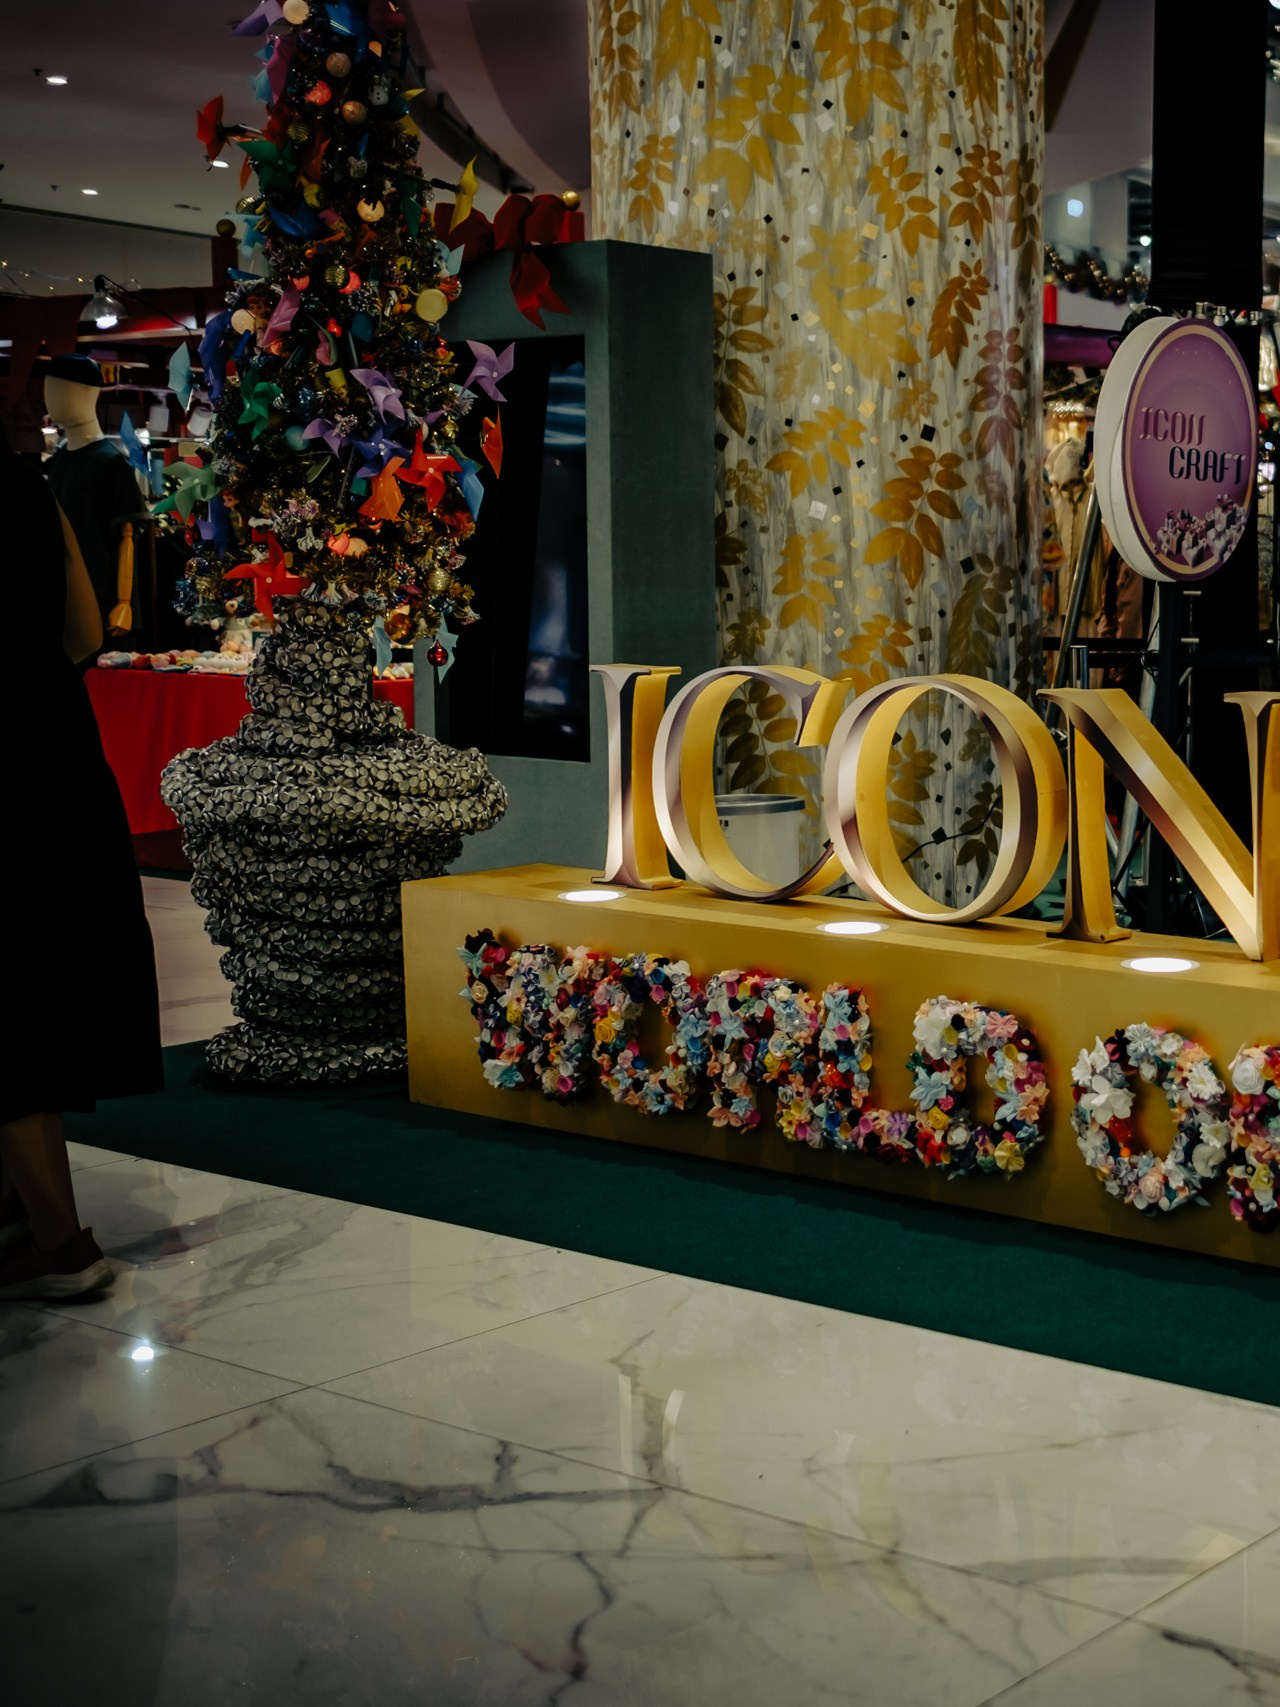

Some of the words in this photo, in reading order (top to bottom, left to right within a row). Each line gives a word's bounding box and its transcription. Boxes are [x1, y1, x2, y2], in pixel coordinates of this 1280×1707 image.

[1139, 406, 1205, 446] ICON
[1169, 446, 1246, 485] CRAFT
[457, 929, 1047, 1180] WORLD
